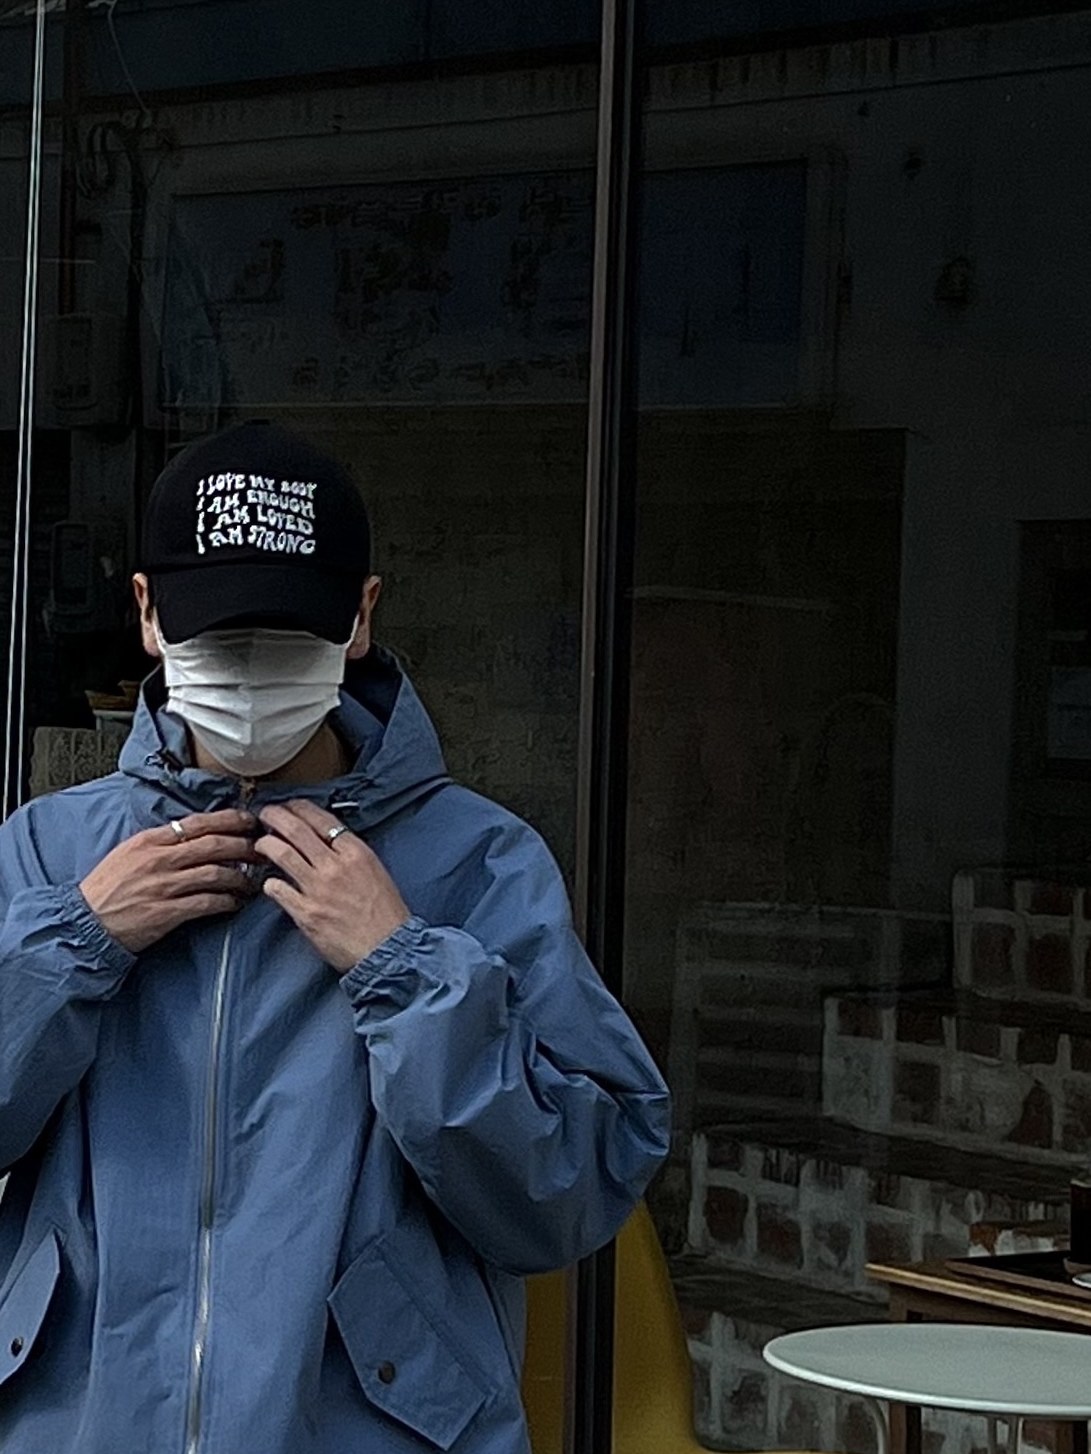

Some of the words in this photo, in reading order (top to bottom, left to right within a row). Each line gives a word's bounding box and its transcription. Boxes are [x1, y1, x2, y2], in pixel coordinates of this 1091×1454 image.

[196, 479, 205, 496] I
[206, 472, 246, 496] LOVE
[249, 474, 275, 491] MY
[281, 480, 317, 500] BODY
[196, 496, 205, 511] I
[207, 492, 240, 514] AM
[246, 489, 316, 520] ENOUGH
[197, 511, 205, 533] I
[212, 505, 250, 530] AM
[256, 504, 314, 535] LOVED
[195, 534, 206, 554] I
[208, 525, 244, 547] AM
[247, 525, 316, 554] STRONG
